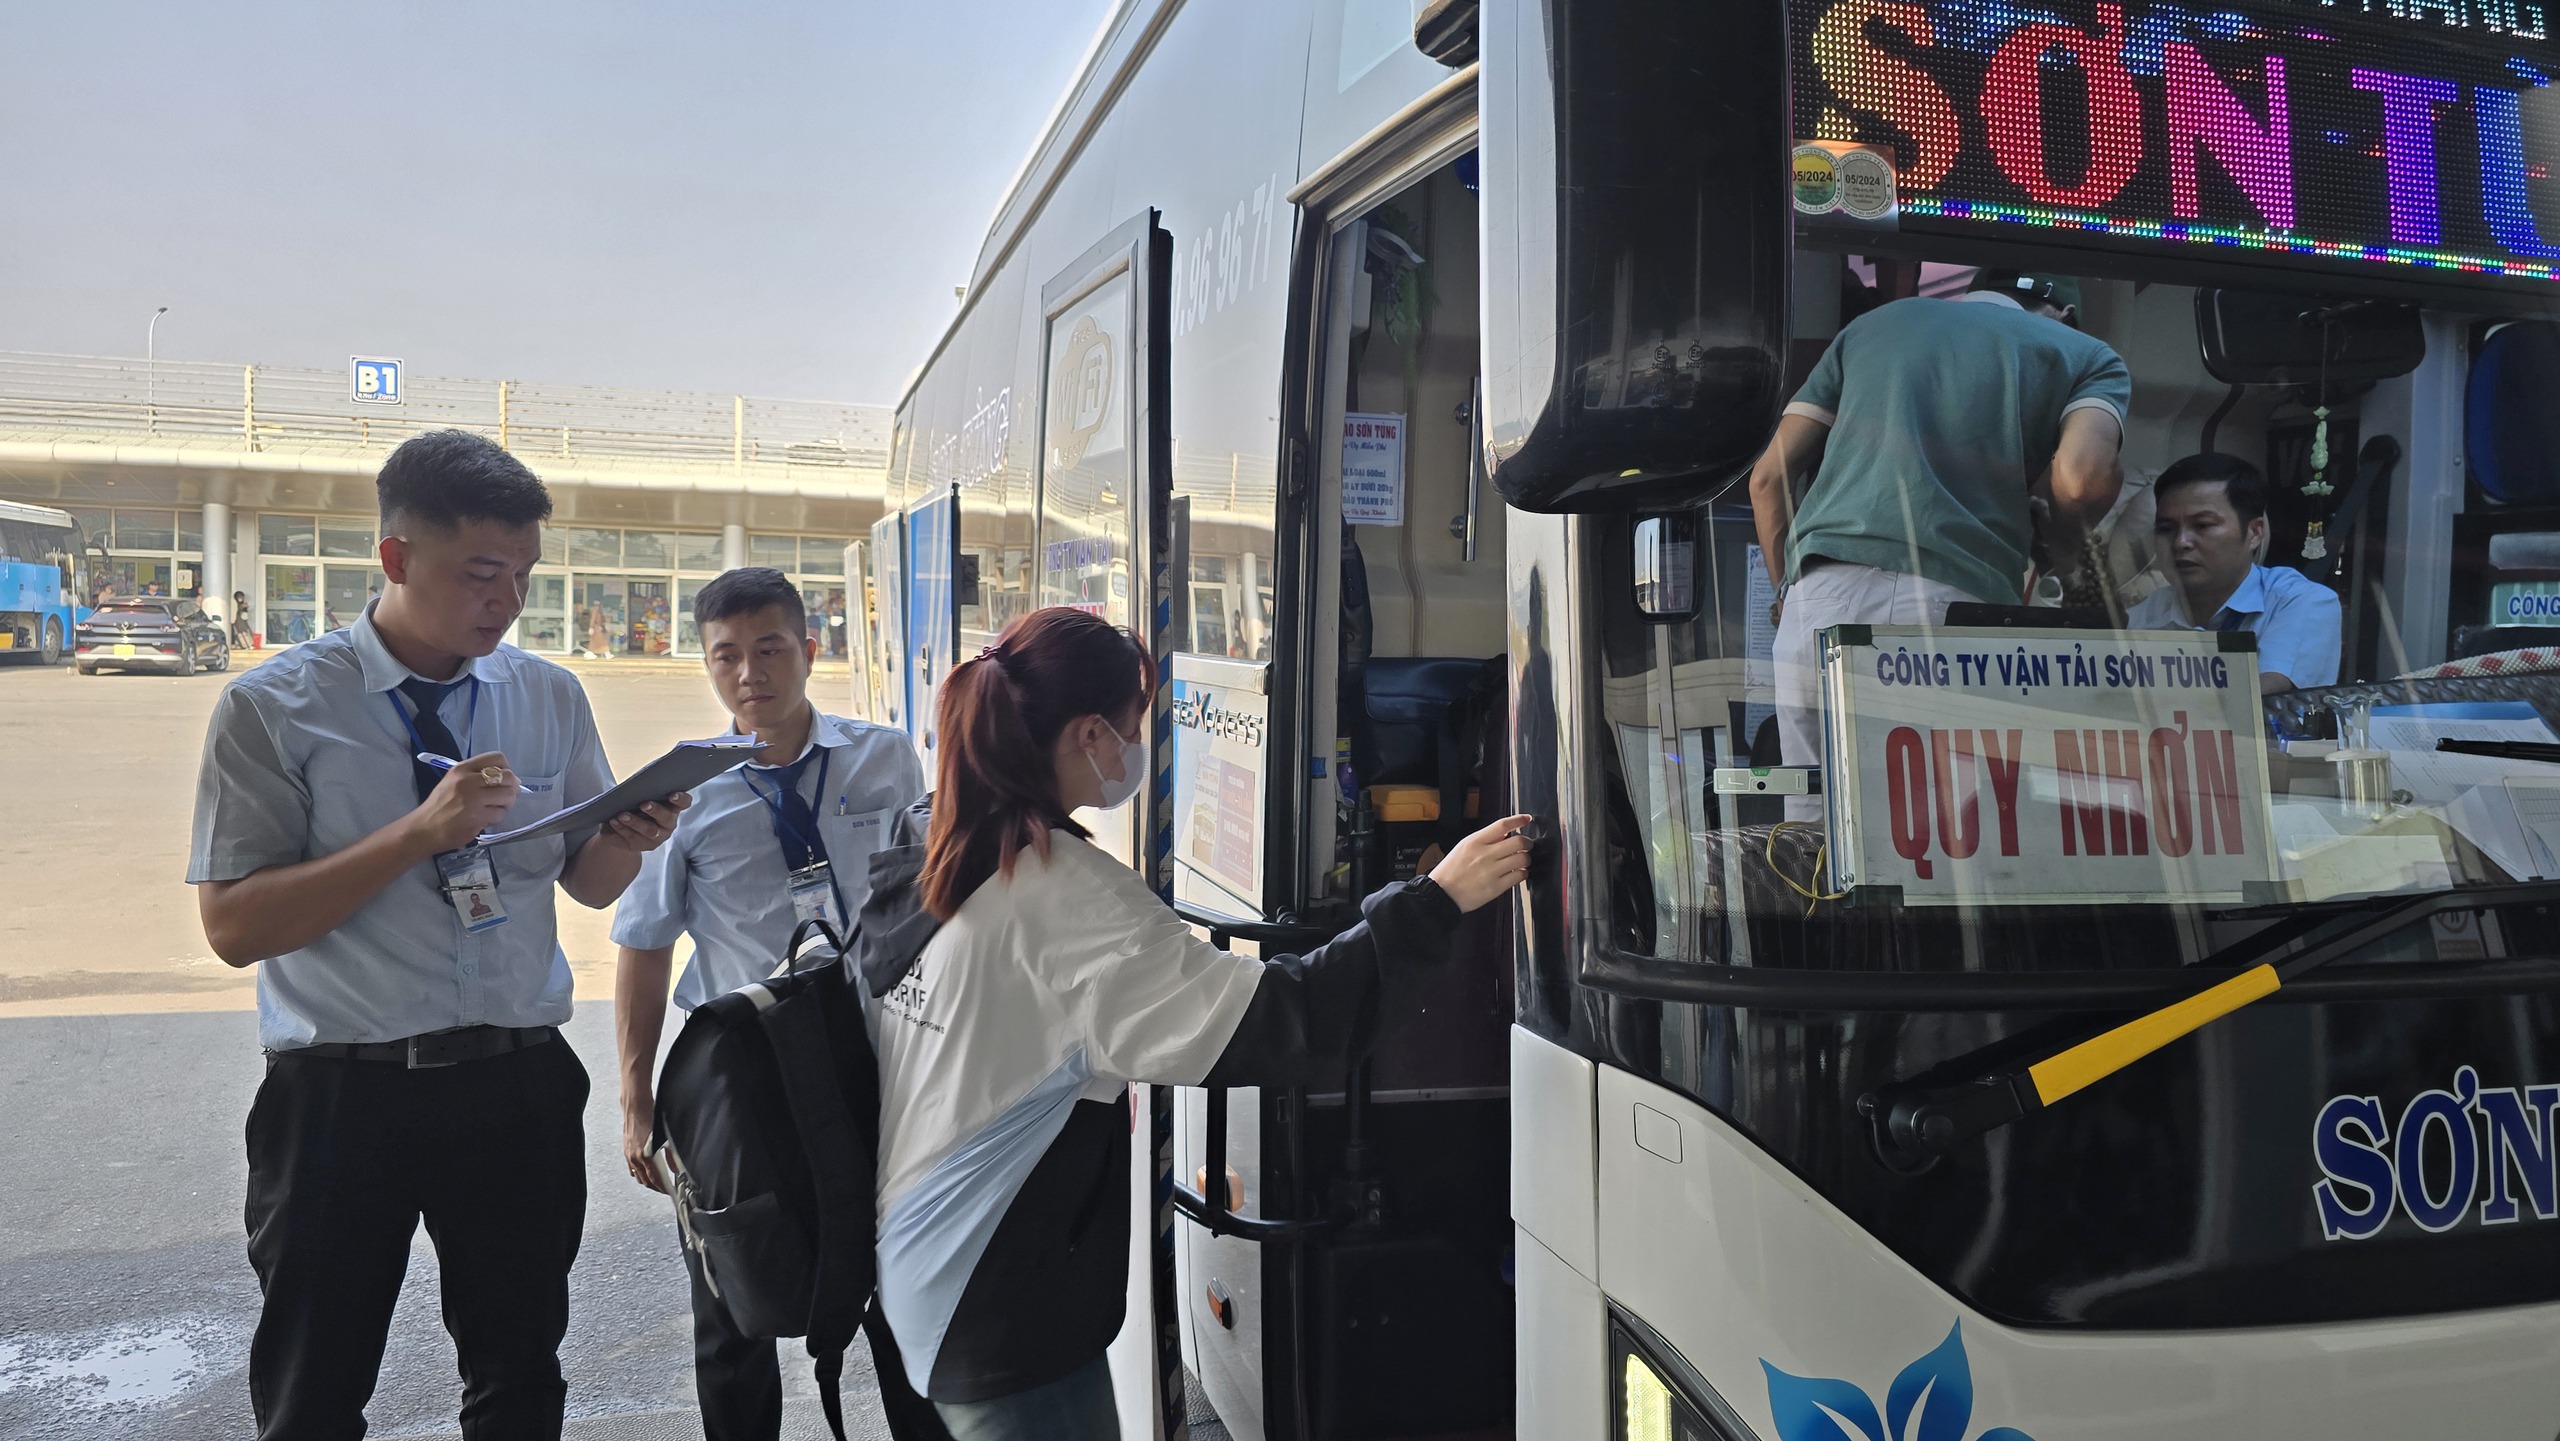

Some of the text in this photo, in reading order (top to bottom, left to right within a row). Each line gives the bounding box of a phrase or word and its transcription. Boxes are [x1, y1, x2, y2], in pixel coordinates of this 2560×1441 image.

[1812, 0, 2296, 230] SƠN
[1845, 174, 1881, 186] 05/2024
[1216, 200, 1245, 313] 96
[1249, 173, 1276, 292] 71
[358, 365, 396, 394] B1
[1356, 421, 1372, 438] SƠN
[2508, 589, 2560, 617] CÔNG
[1877, 643, 2228, 695] CÔNG TY VẬN TẢI SƠN TÙNG
[1886, 726, 2023, 880] QUY
[2053, 710, 2244, 858] NHƠN
[2312, 1064, 2560, 1241] SƠN
